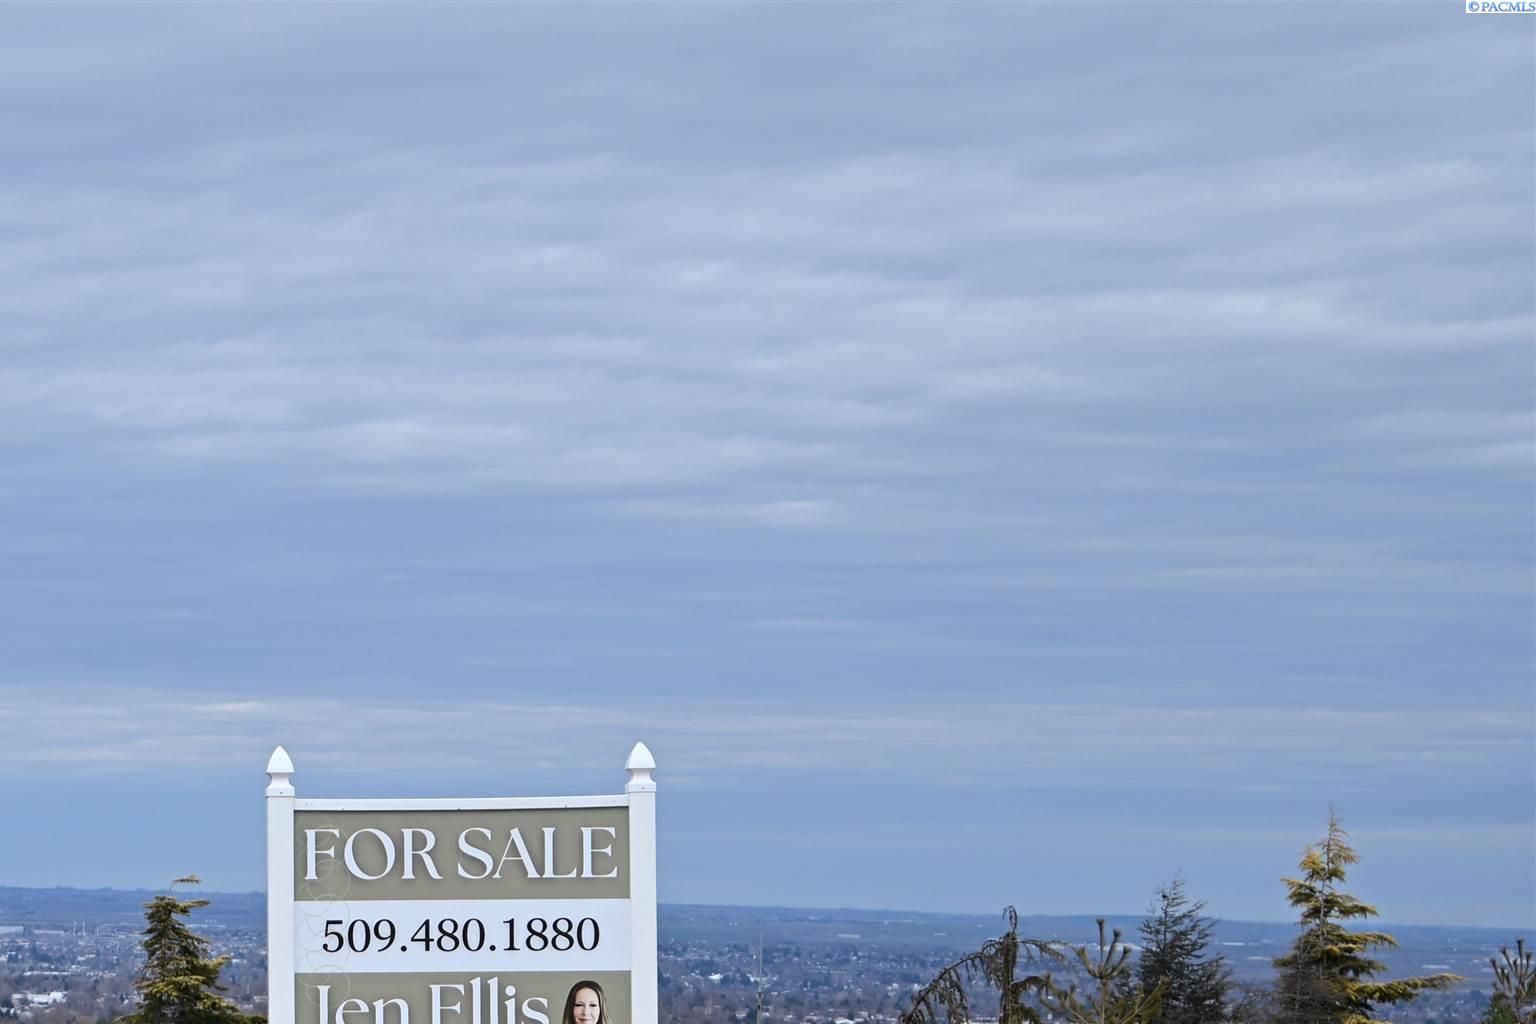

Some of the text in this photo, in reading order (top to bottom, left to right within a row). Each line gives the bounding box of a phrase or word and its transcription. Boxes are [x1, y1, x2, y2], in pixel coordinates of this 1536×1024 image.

[304, 827, 618, 880] FOR SALE
[322, 917, 600, 952] 509.480.1880
